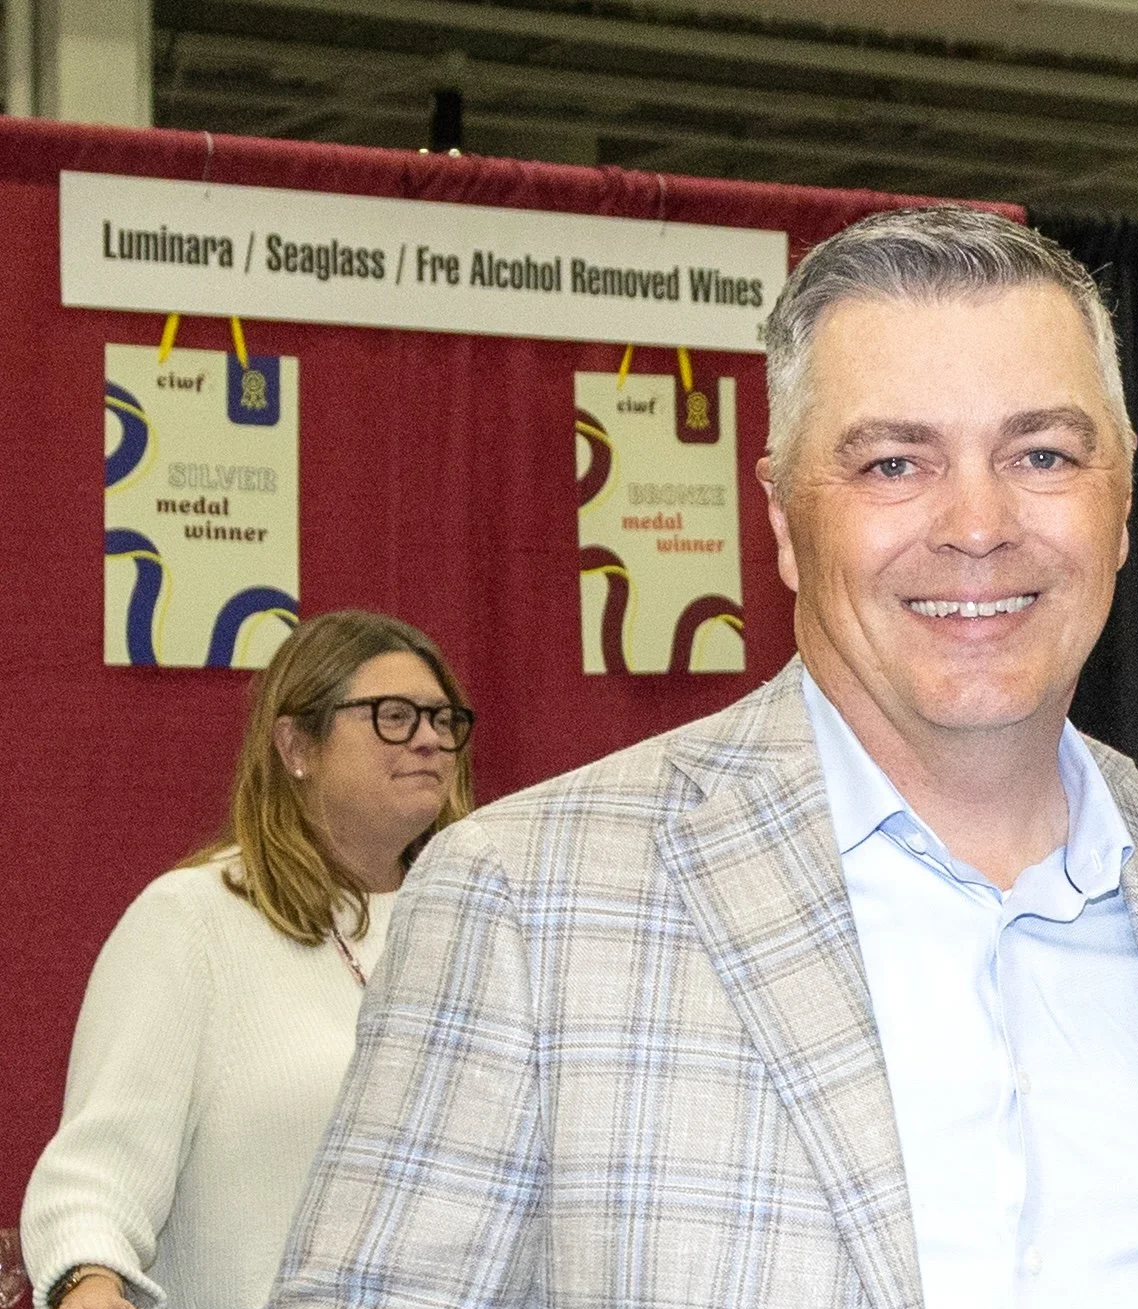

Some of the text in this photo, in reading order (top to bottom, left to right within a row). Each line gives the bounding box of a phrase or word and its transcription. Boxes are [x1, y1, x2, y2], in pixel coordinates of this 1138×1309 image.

[102, 219, 234, 268] Luminara
[265, 232, 386, 282] Seaglass
[415, 245, 460, 286] Fre
[469, 249, 562, 293] Alcohol
[570, 256, 680, 302] Removed
[688, 265, 764, 308] Wines
[167, 462, 278, 494] SILVER
[627, 481, 727, 507] BRONZE
[156, 496, 229, 517] medal
[184, 520, 269, 542] winner
[620, 511, 684, 531] medal
[655, 533, 725, 553] winner
